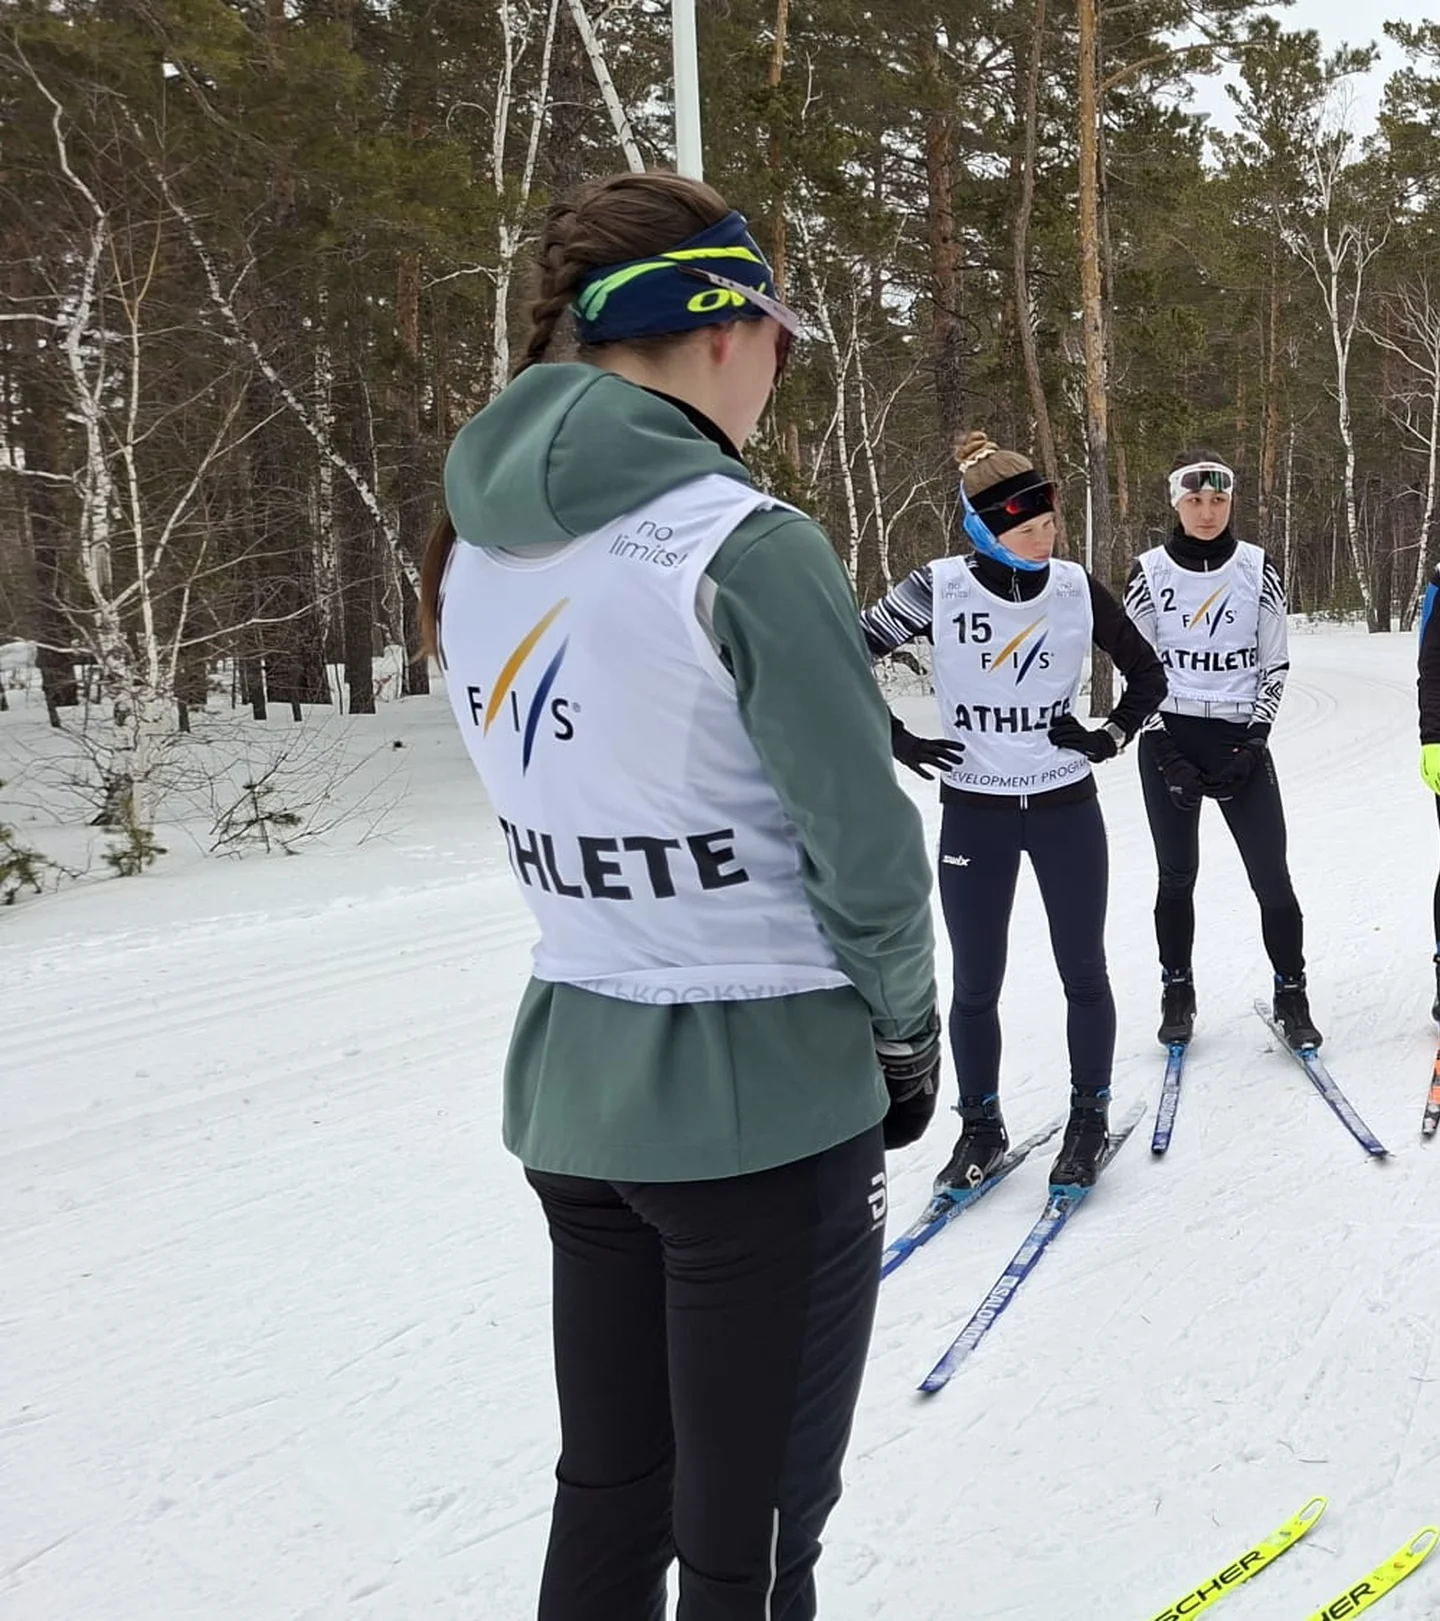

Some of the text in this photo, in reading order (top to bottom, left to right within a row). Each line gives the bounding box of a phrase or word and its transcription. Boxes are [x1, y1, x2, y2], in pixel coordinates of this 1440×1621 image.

[637, 521, 673, 541] no
[610, 535, 688, 568] limits!
[1160, 588, 1177, 612] 2
[953, 612, 992, 643] 15
[498, 815, 750, 900] HLETE
